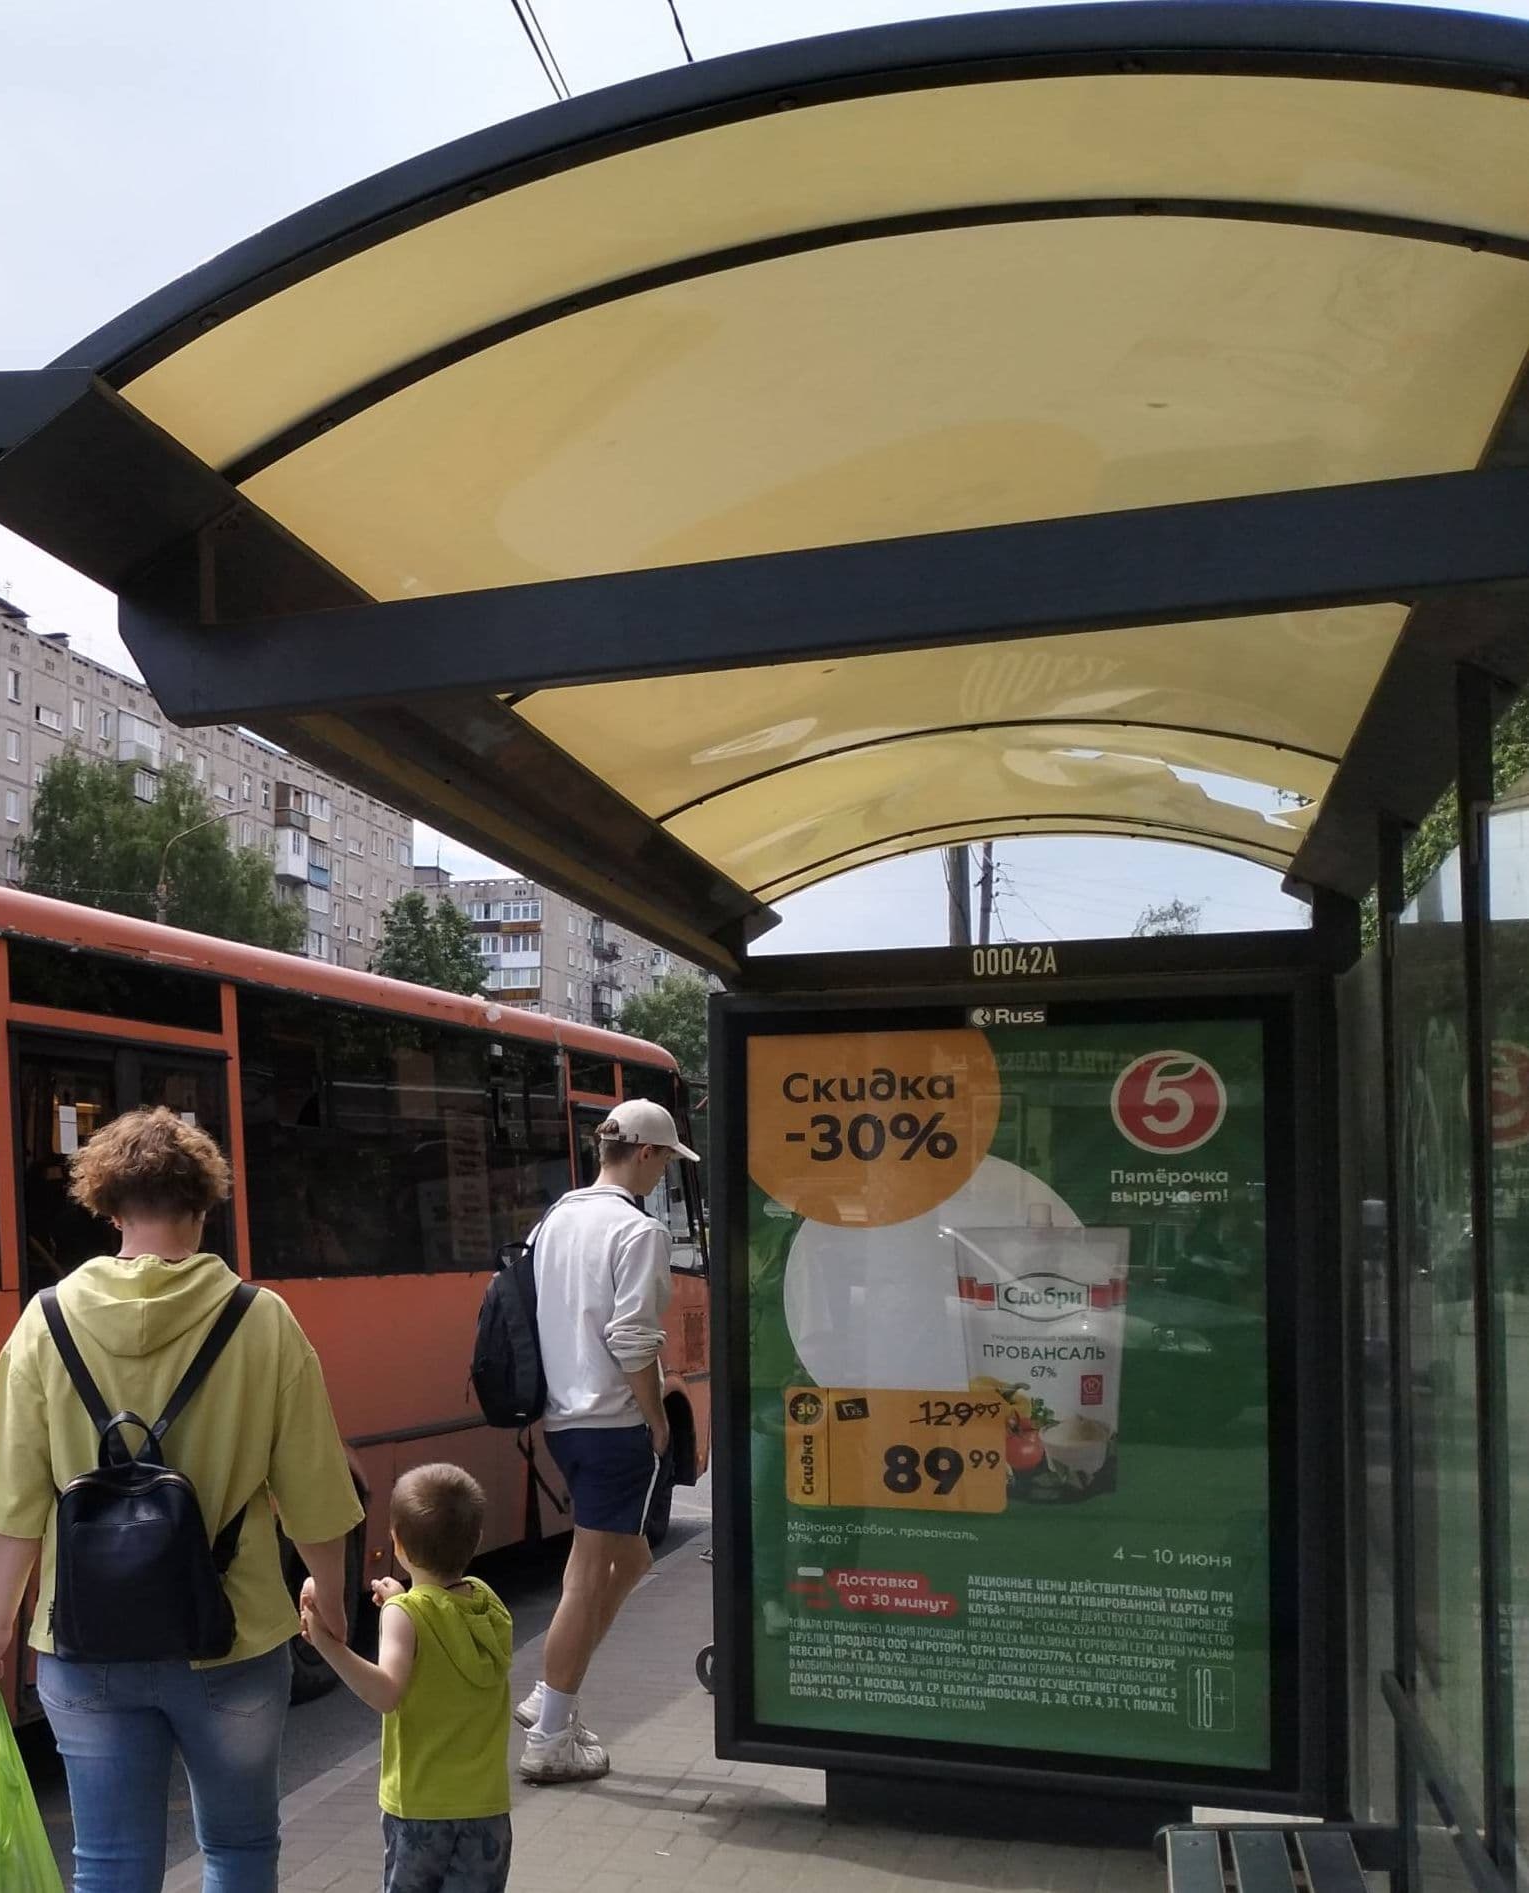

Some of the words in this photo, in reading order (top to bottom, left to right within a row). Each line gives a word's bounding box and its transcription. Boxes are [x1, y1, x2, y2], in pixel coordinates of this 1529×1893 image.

[973, 945, 1057, 976] 00042A
[995, 1008, 1045, 1024] Russ
[782, 1067, 955, 1104] Скидка
[785, 1111, 958, 1162] -30%
[1110, 1168, 1229, 1187] Пятёрочка
[1110, 1188, 1229, 1207] выручает!
[1004, 1287, 1082, 1309] Сдобри
[983, 1344, 1106, 1361] ПРОВАНСАЛЬ
[1030, 1365, 1058, 1378] 67%
[801, 1434, 815, 1495] Скидка
[883, 1444, 965, 1495] 89
[968, 1449, 1001, 1470] 99
[787, 1521, 843, 1533] Майонез
[846, 1523, 897, 1538] Сдобри,
[818, 1534, 842, 1545] 400
[1113, 1546, 1125, 1561] 4
[1153, 1549, 1173, 1565] 10
[1179, 1553, 1232, 1568] июня
[837, 1572, 917, 1591] Доставка
[967, 1574, 1032, 1589] АКЦИОННЫЕ
[1036, 1579, 1066, 1591] ЦЕНЫ
[1069, 1581, 1161, 1597] ДЕЙСТВИТЕЛЬНЫ
[1165, 1587, 1207, 1600] ТОЛЬКО
[1211, 1590, 1233, 1602] ПРИ
[848, 1593, 867, 1605] от
[871, 1595, 889, 1607] 30
[894, 1596, 949, 1613] минут
[968, 1588, 1056, 1605] ПРЕДЪЯВЛЕНИИ
[1060, 1594, 1165, 1612] АКТИВИРОВАННОЙ
[1170, 1602, 1208, 1615] КАРТЫ
[833, 1634, 885, 1648] ПРОДАВЕЦ
[887, 1638, 907, 1650] ООО
[970, 1644, 995, 1657] ОГРН
